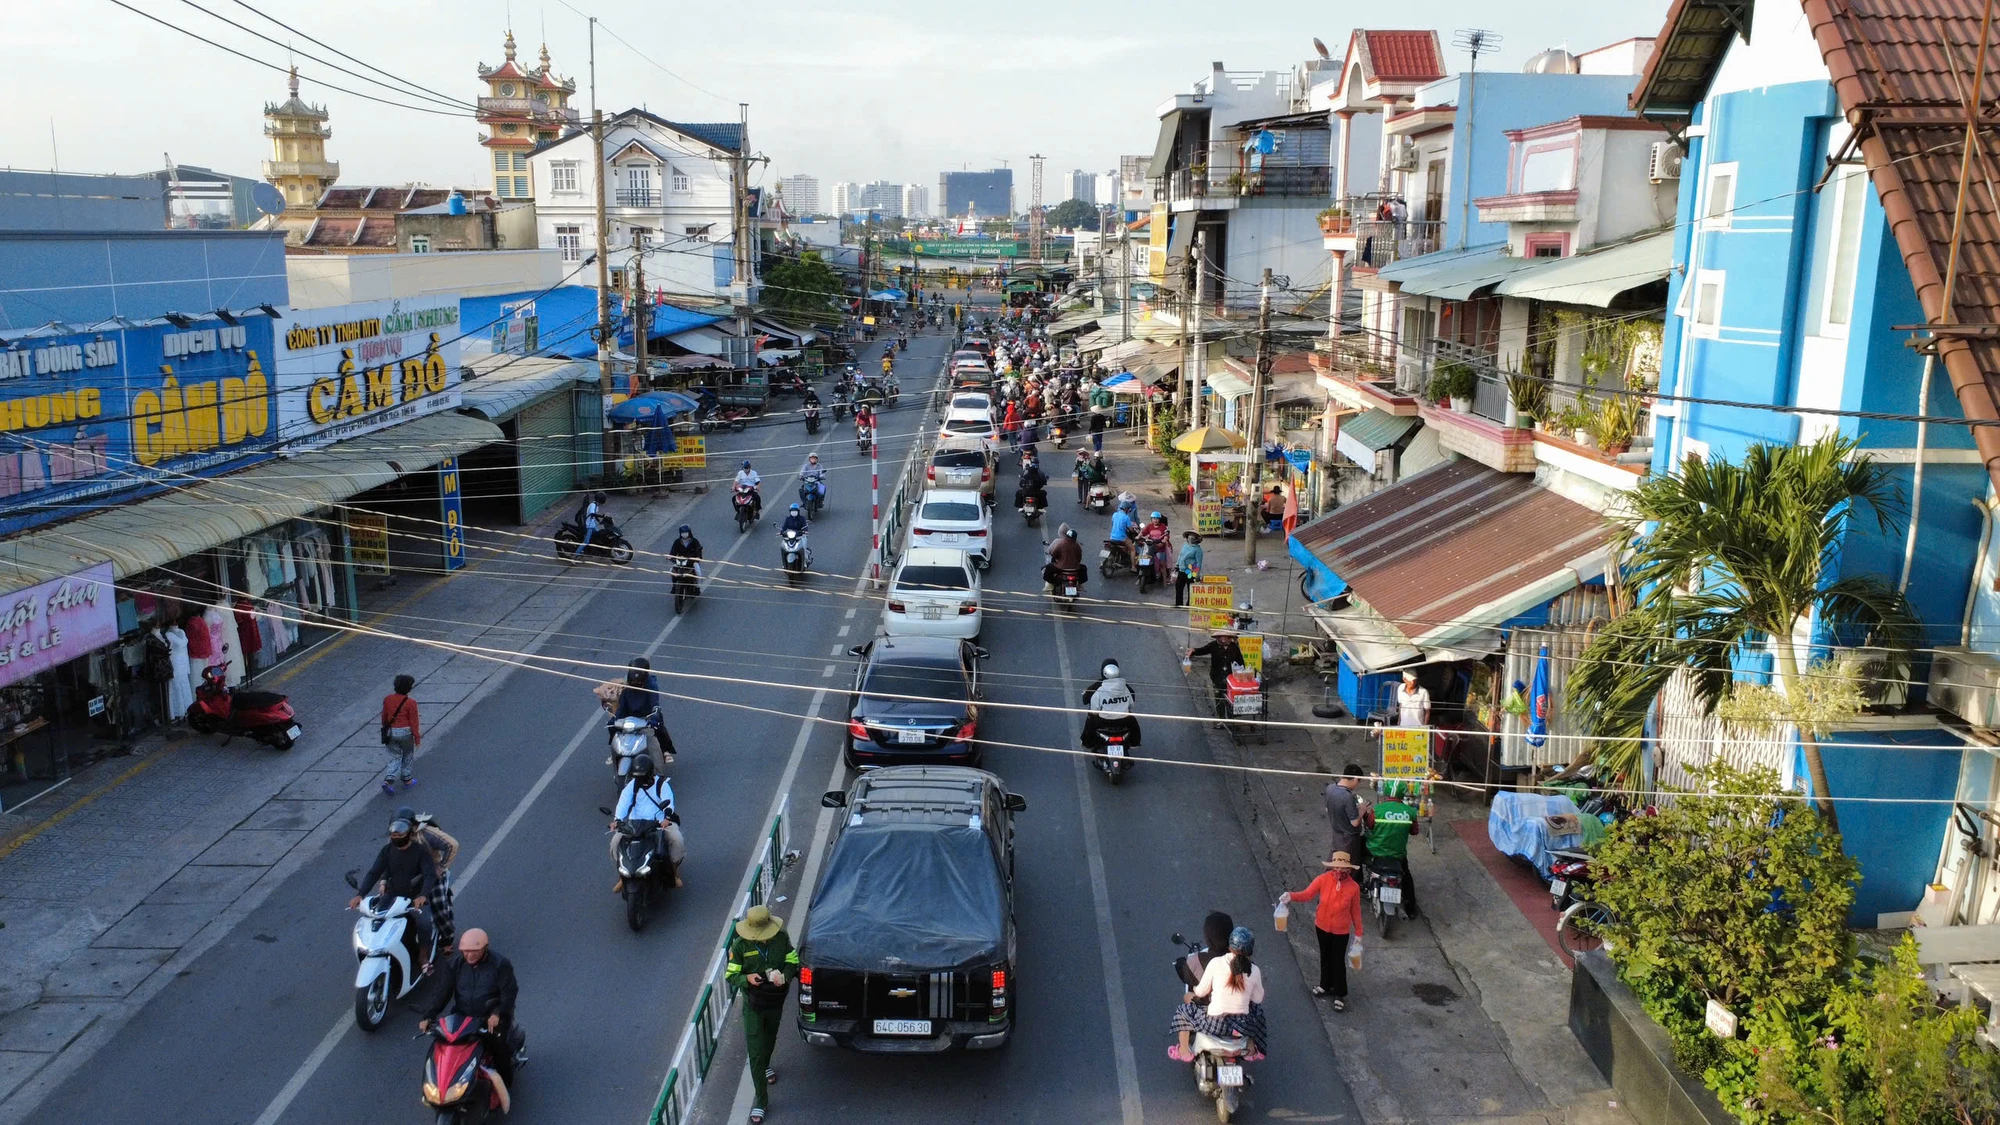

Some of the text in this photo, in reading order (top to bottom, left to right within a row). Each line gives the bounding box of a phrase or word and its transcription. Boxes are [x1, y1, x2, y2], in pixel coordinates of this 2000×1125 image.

[163, 325, 246, 360] DỊCH VỤ
[286, 322, 318, 350] CÔNG
[319, 325, 333, 346] TY
[335, 322, 361, 344] TNHH
[362, 317, 381, 338] MTV
[414, 305, 458, 330] NHUNG
[0, 334, 118, 379] BẤT ĐỘNG SẢN
[308, 348, 394, 424] CẦM
[132, 350, 268, 466] CẦM ĐỒ
[1211, 597, 1228, 606] CHIA
[20, 641, 35, 657] &
[1385, 811, 1410, 821] Grab
